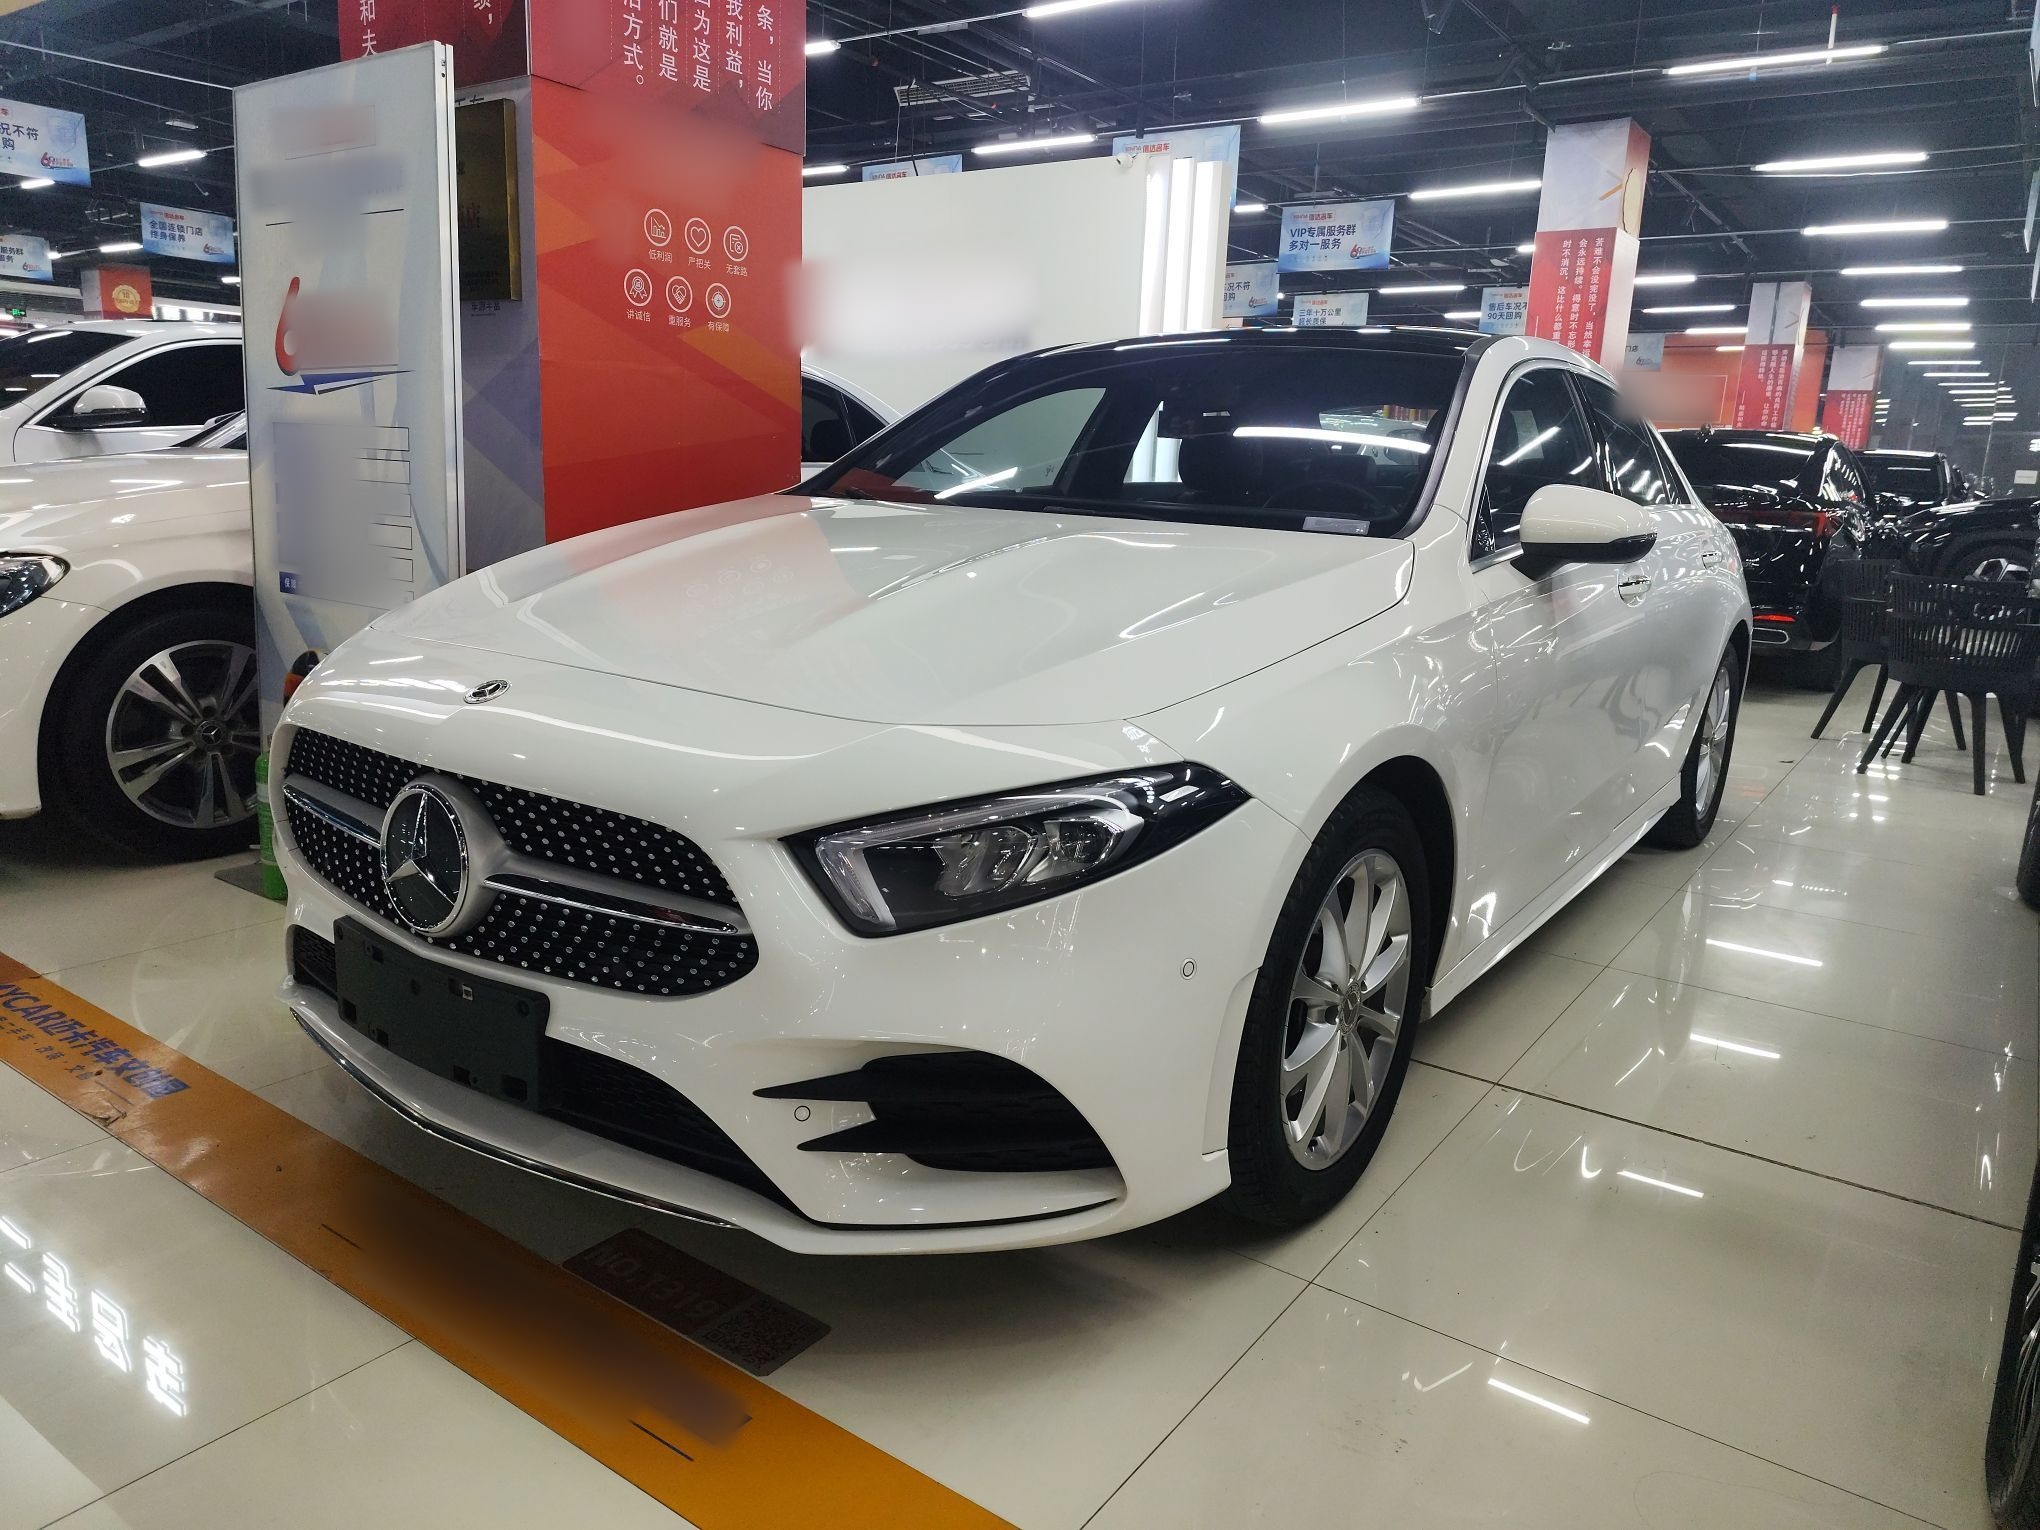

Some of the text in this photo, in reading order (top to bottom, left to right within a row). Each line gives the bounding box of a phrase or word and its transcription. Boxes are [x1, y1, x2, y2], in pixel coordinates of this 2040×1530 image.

[1290, 223, 1357, 238] VIP专属服务群
[1288, 238, 1342, 252] 多对一服务
[626, 309, 651, 322] 讲诚信
